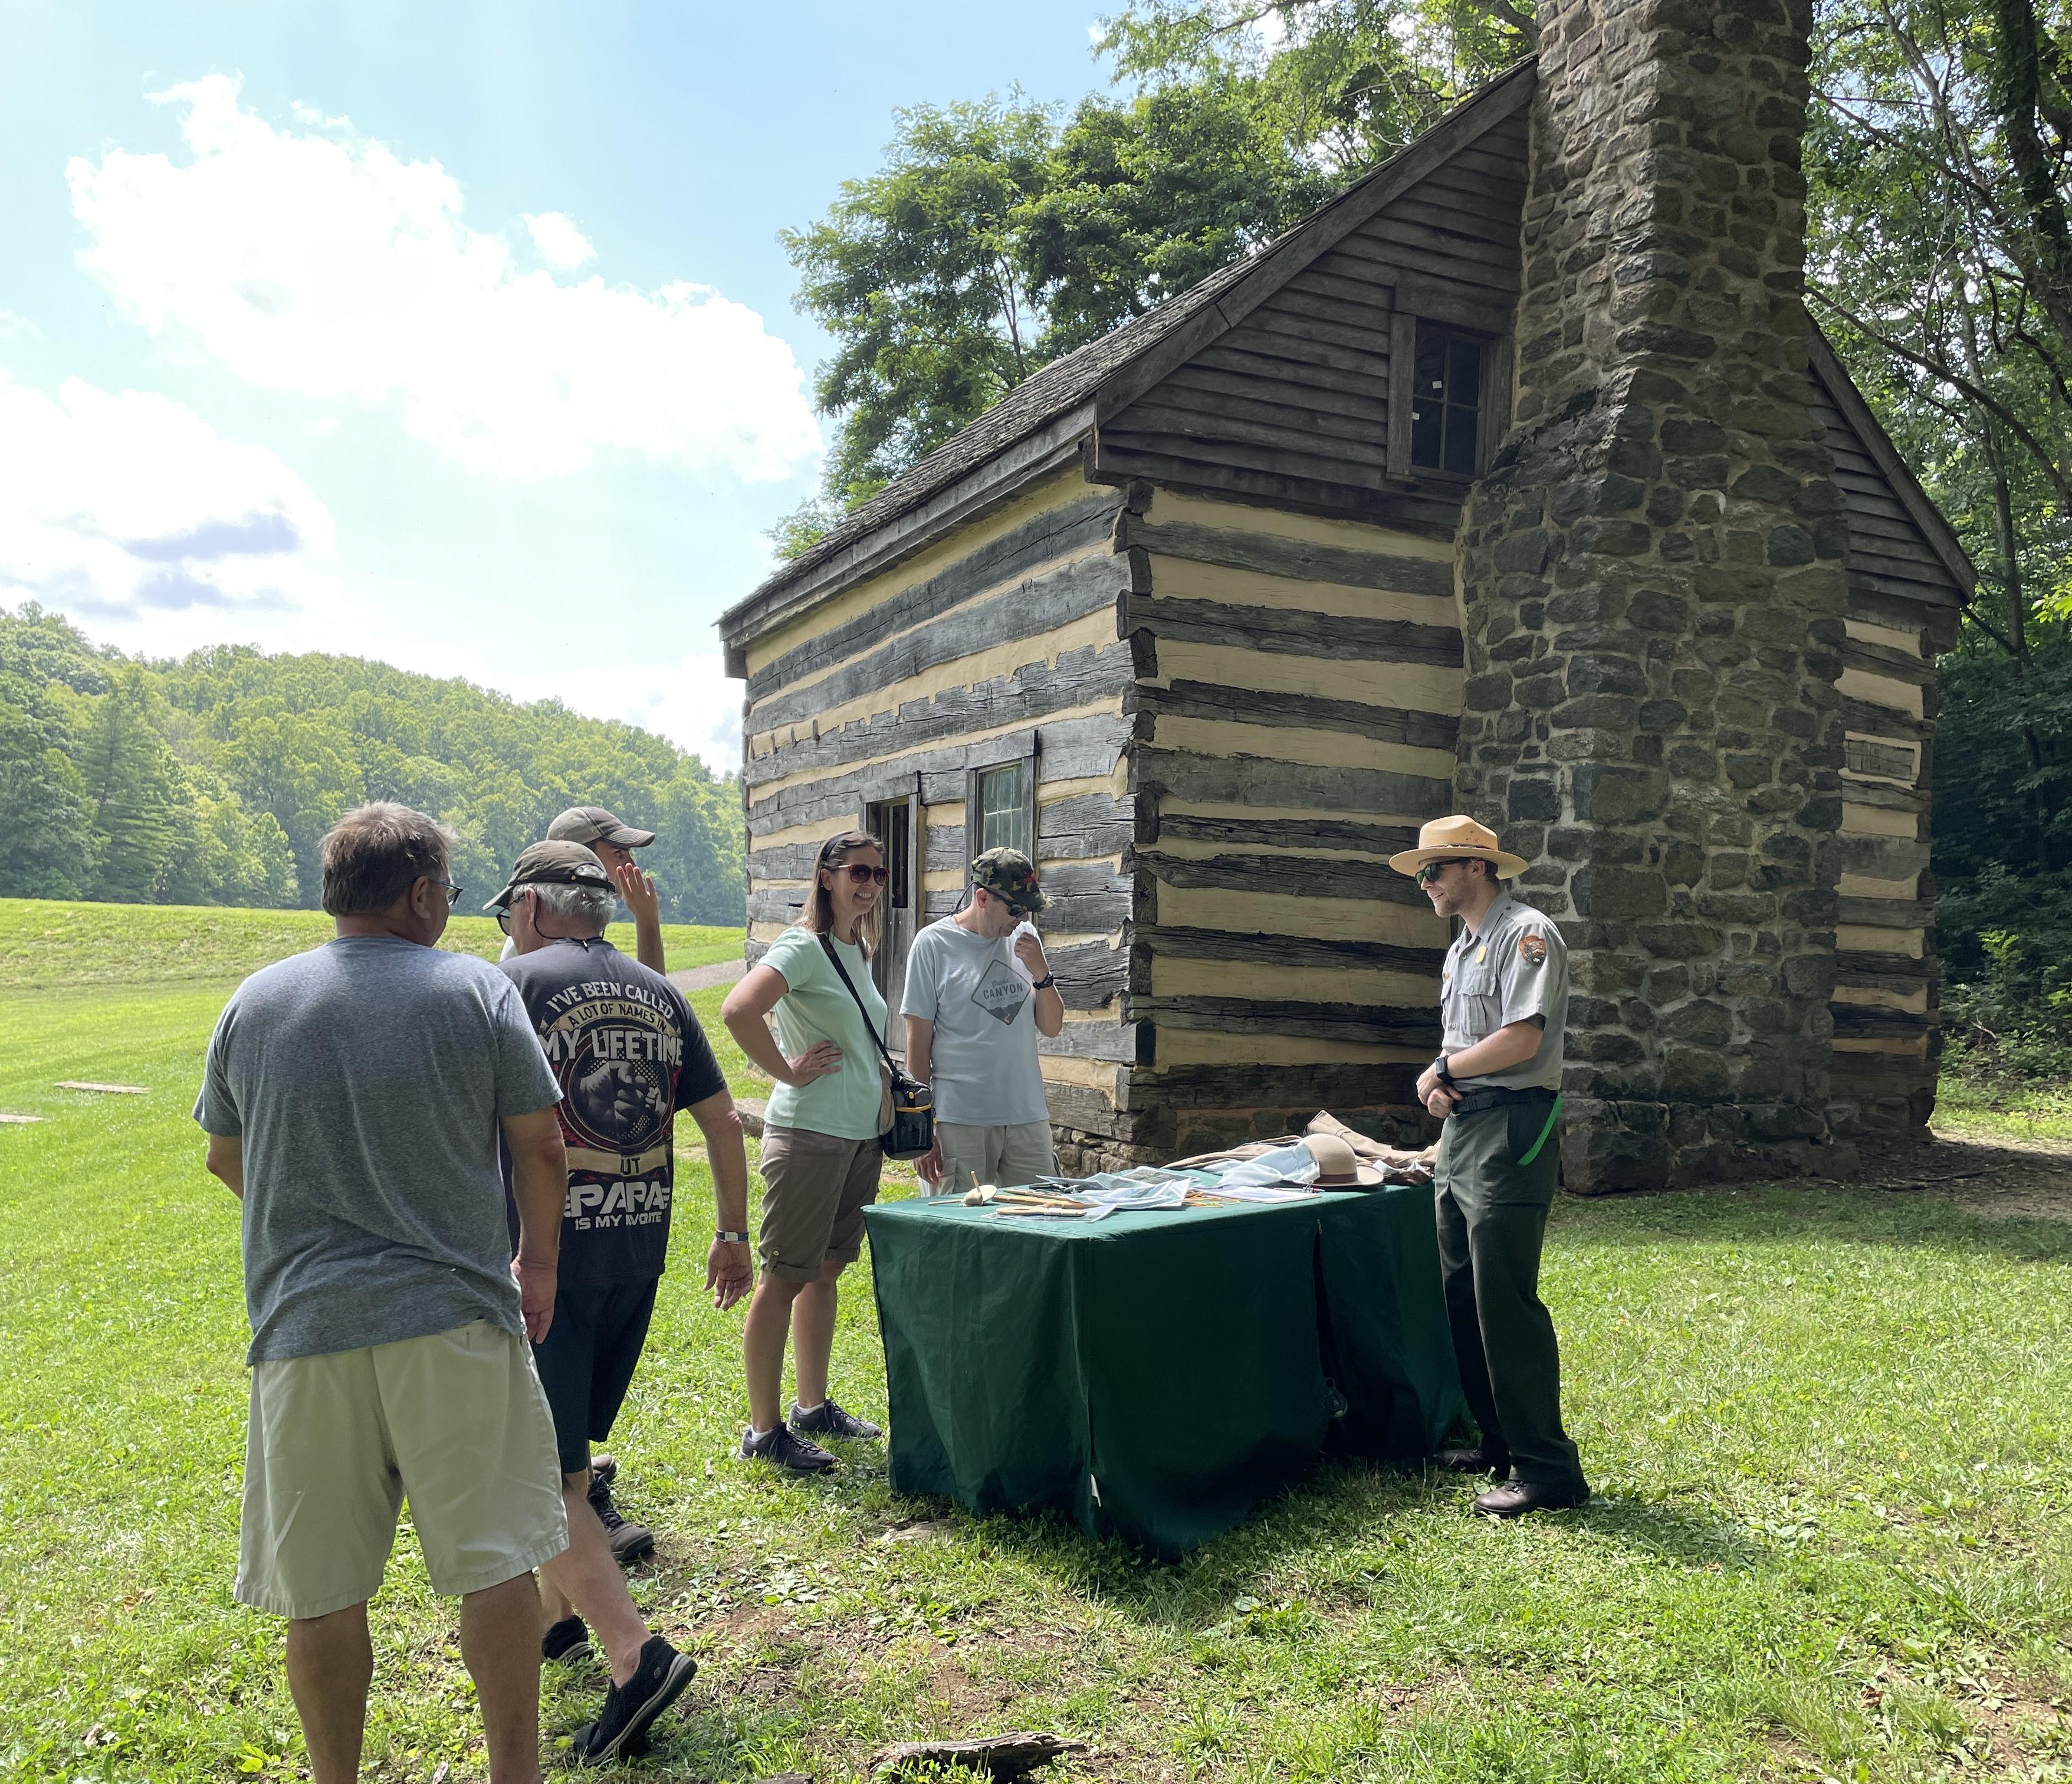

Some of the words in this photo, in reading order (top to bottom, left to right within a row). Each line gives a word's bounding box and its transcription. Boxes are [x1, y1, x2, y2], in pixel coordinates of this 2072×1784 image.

[546, 986, 582, 1012] I'VE
[580, 982, 621, 999] BEEN
[625, 984, 674, 1019] CALLED
[983, 982, 1023, 999] CANYON
[568, 1016, 580, 1028] A
[577, 1005, 599, 1021] LOT
[600, 1003, 613, 1015] OF
[618, 1004, 655, 1022] NAMES
[656, 1018, 668, 1032] IN
[538, 1029, 580, 1061] MY
[570, 1180, 665, 1218] PAPA
[575, 1217, 591, 1230] IS
[595, 1214, 622, 1228] MY
